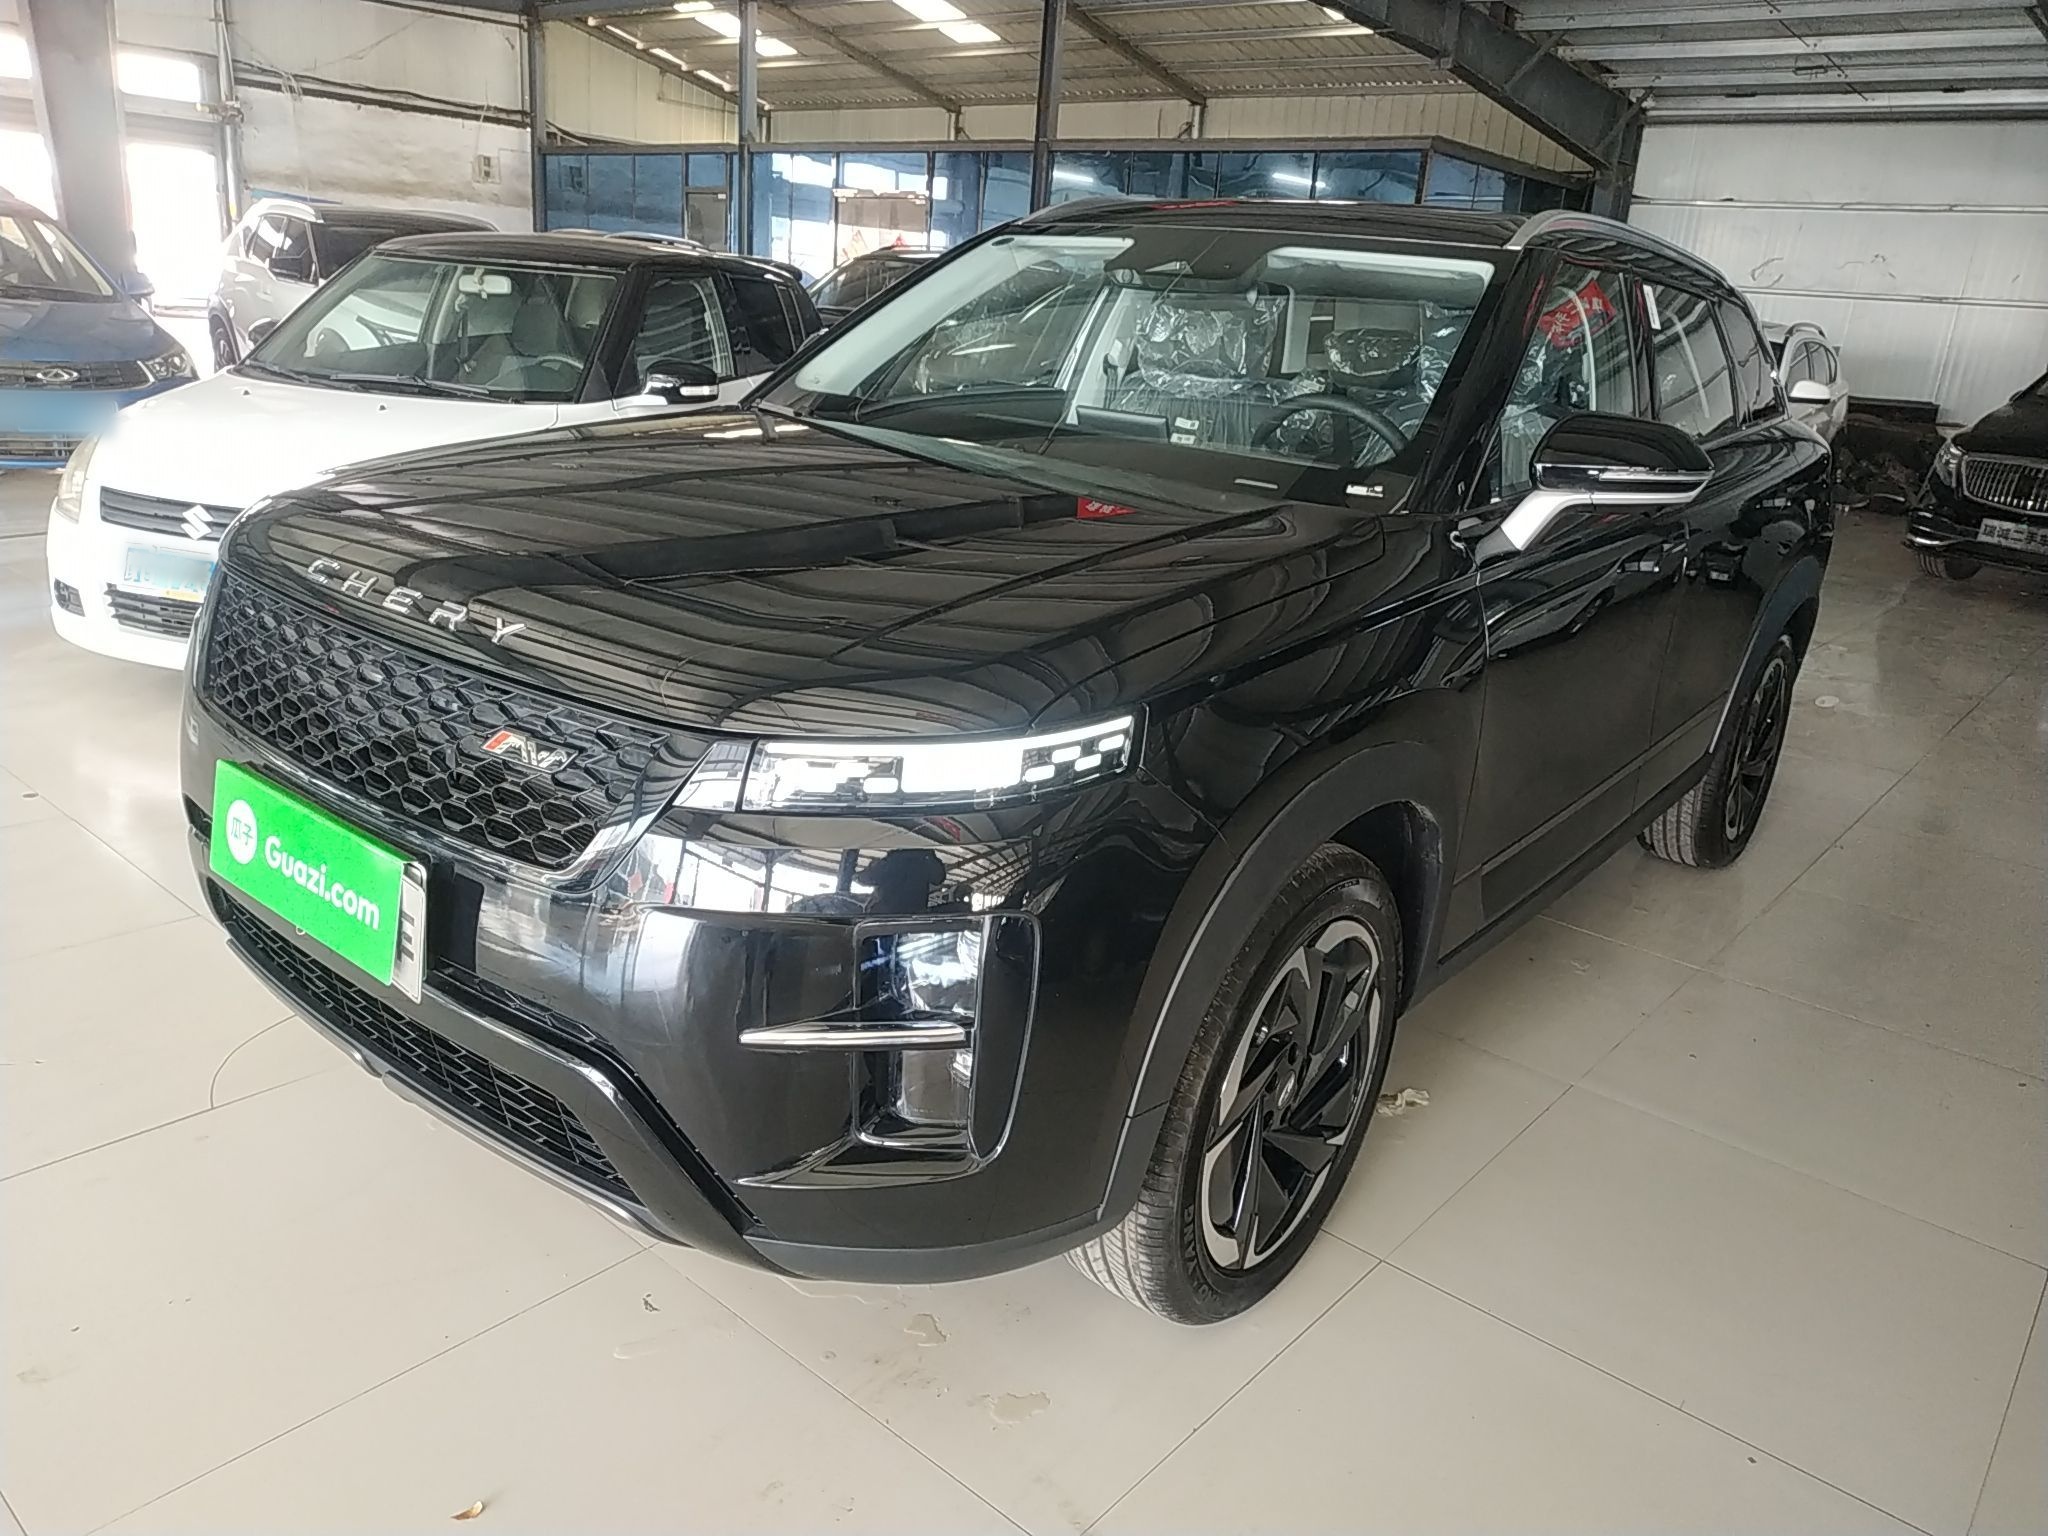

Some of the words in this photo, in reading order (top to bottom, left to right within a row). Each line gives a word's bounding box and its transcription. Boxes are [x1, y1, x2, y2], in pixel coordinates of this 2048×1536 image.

[307, 556, 528, 646] CHERY
[230, 816, 254, 847] 瓜子
[264, 834, 380, 931] Guazi.com
